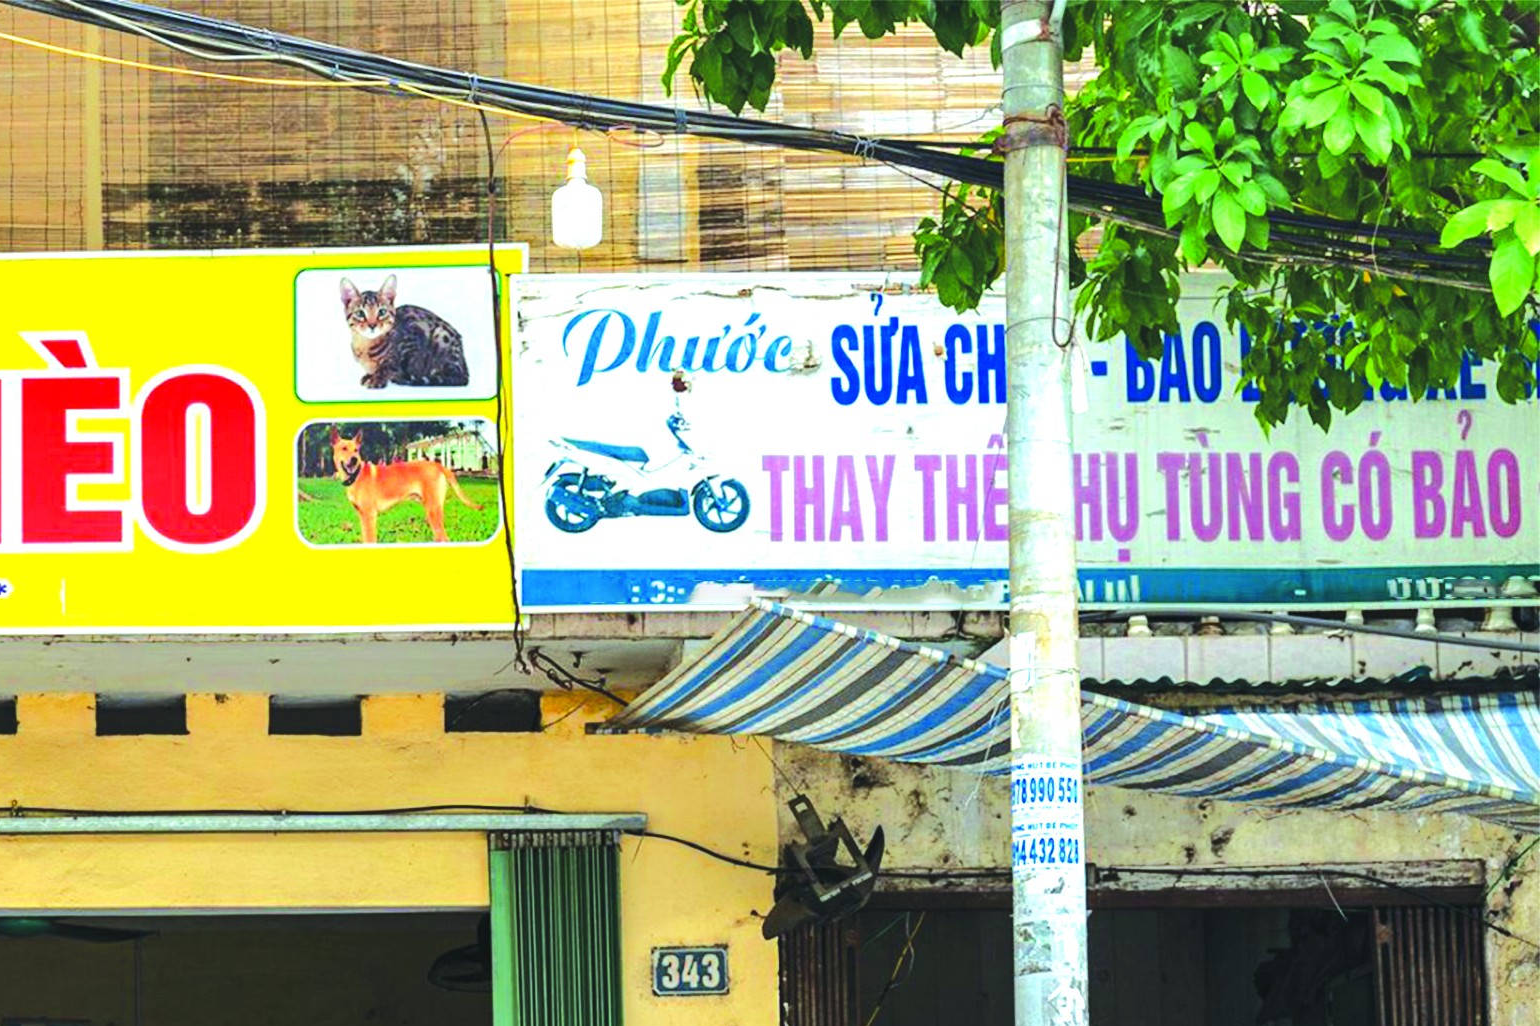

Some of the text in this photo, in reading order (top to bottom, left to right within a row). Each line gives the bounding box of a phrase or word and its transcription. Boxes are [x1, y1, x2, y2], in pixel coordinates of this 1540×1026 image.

[562, 309, 794, 387] Phước
[830, 293, 928, 406] SỬA
[762, 454, 896, 542] THAY
[1073, 452, 1140, 563] HỤ
[1157, 432, 1302, 542] TÙNG
[1320, 430, 1393, 542] CÓ
[1411, 410, 1523, 540] BẢO
[661, 953, 721, 989] 343
